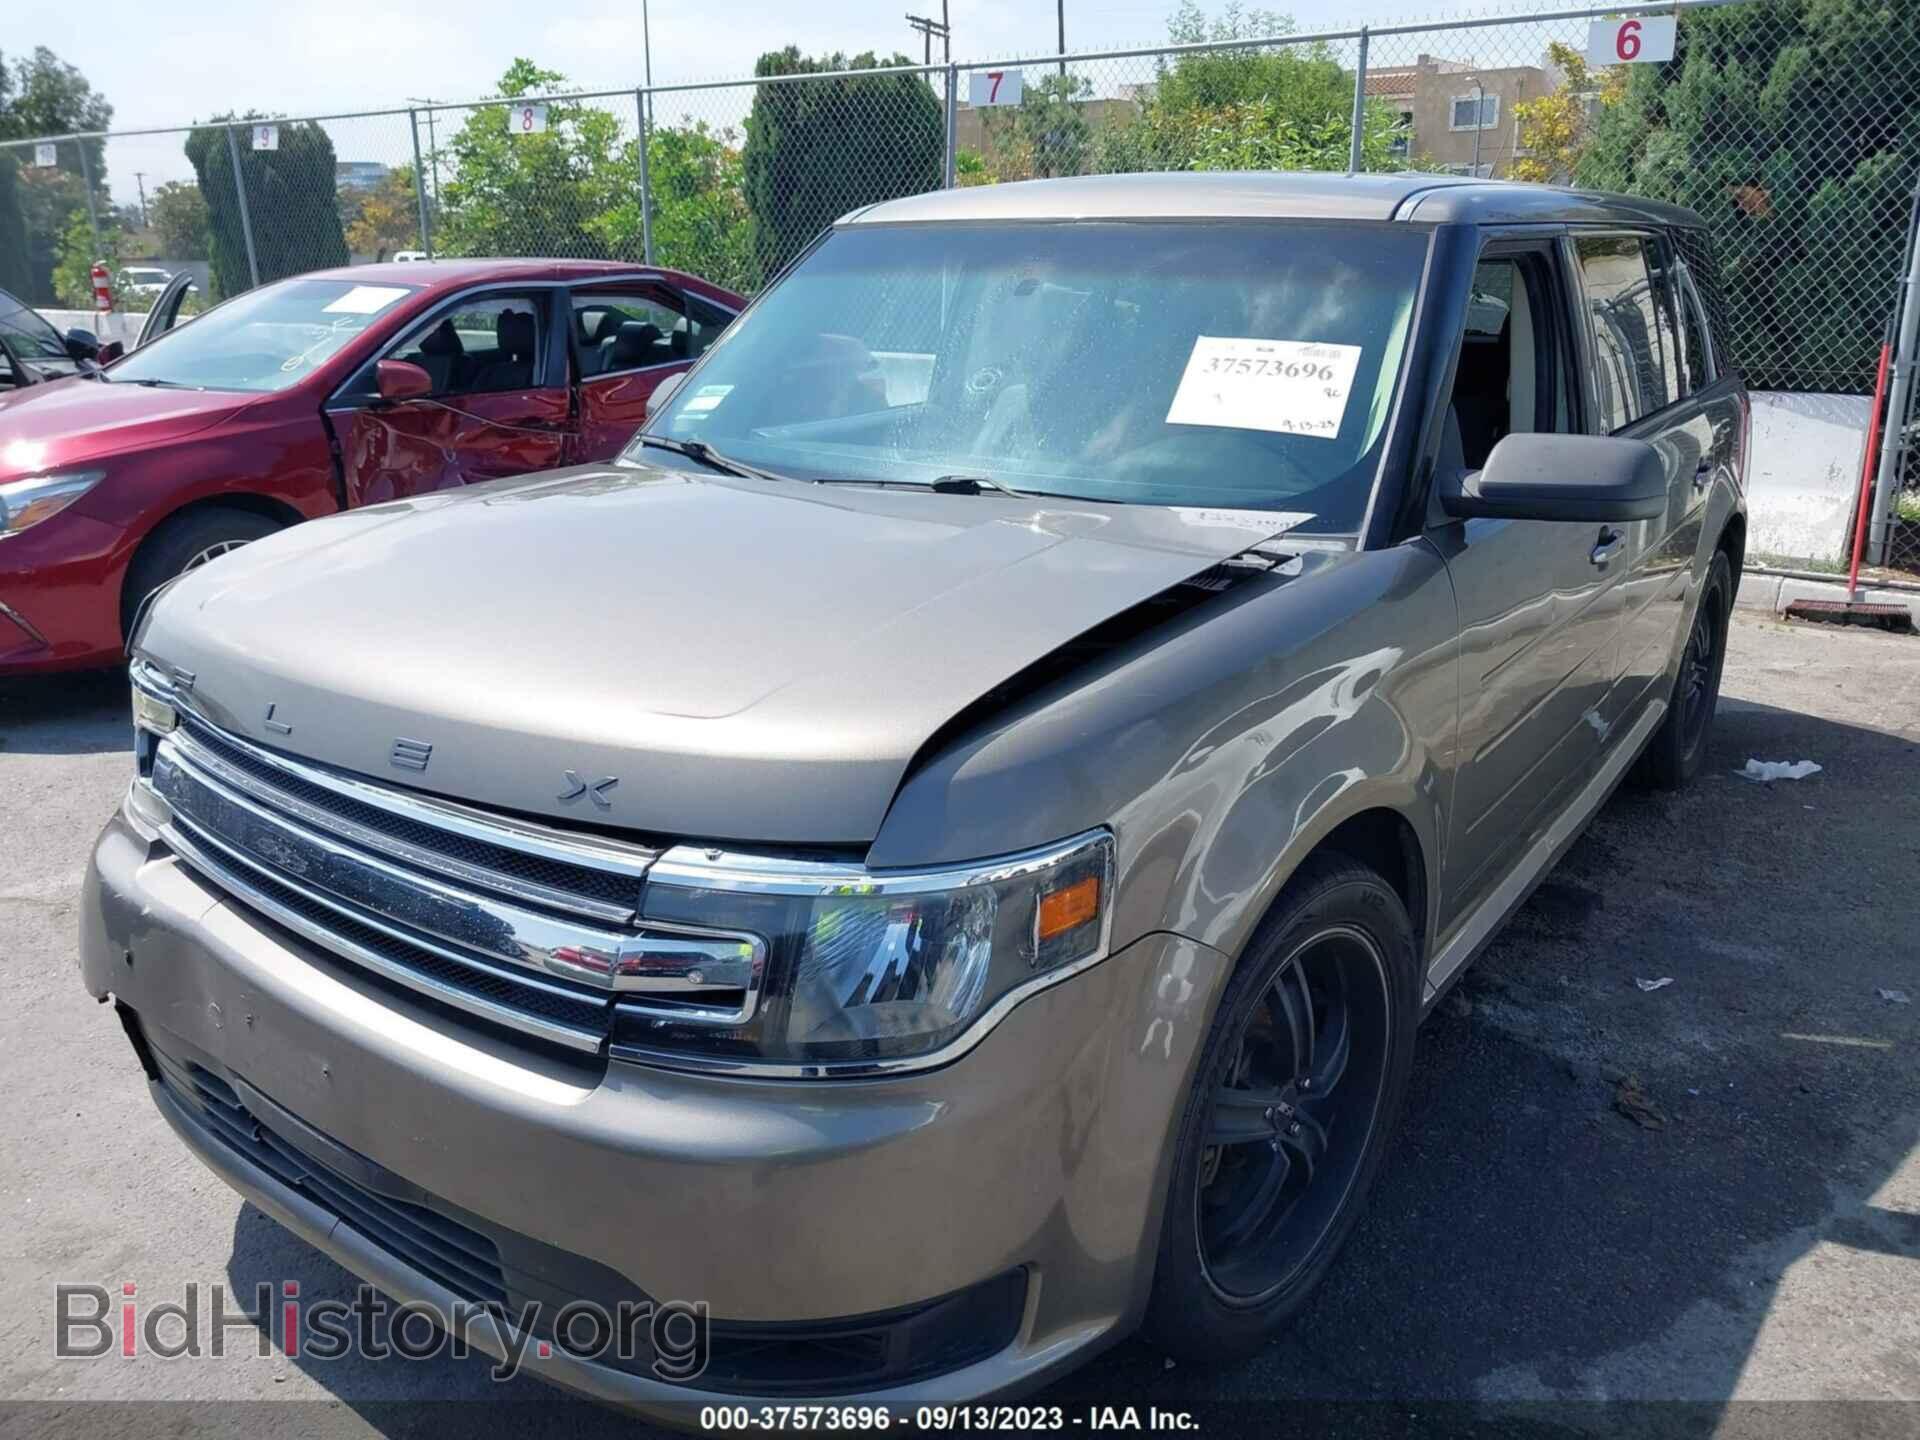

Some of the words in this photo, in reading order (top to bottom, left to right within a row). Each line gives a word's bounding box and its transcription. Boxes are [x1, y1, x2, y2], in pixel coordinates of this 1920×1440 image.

[1616, 19, 1642, 60] 6
[987, 72, 1004, 103] 7
[523, 107, 533, 130] 8
[260, 127, 270, 147] 9
[1202, 356, 1334, 382] 37573696
